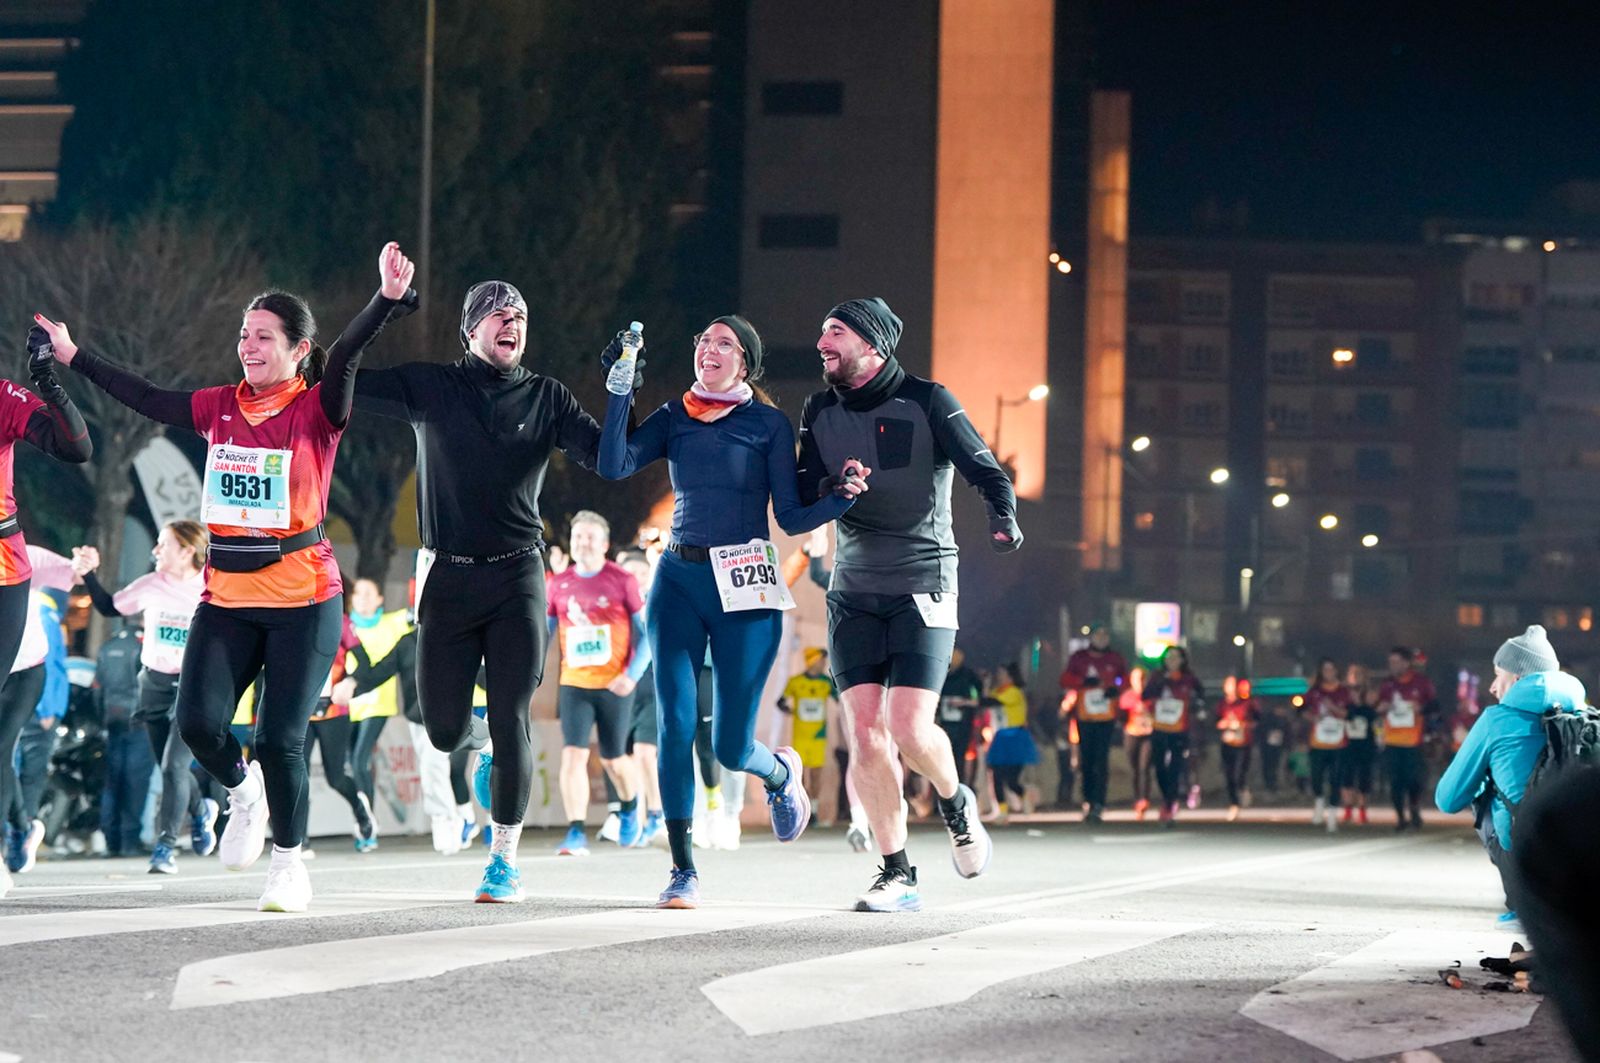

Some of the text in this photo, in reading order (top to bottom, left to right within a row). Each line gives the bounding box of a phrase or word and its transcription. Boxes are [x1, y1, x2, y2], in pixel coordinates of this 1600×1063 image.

[224, 453, 247, 463] NOCHE
[248, 455, 258, 463] DE
[214, 462, 230, 472] SAN
[221, 473, 272, 500] 9531
[729, 547, 753, 558] NOCHE
[721, 558, 738, 569] SAN
[730, 564, 777, 588] 6293
